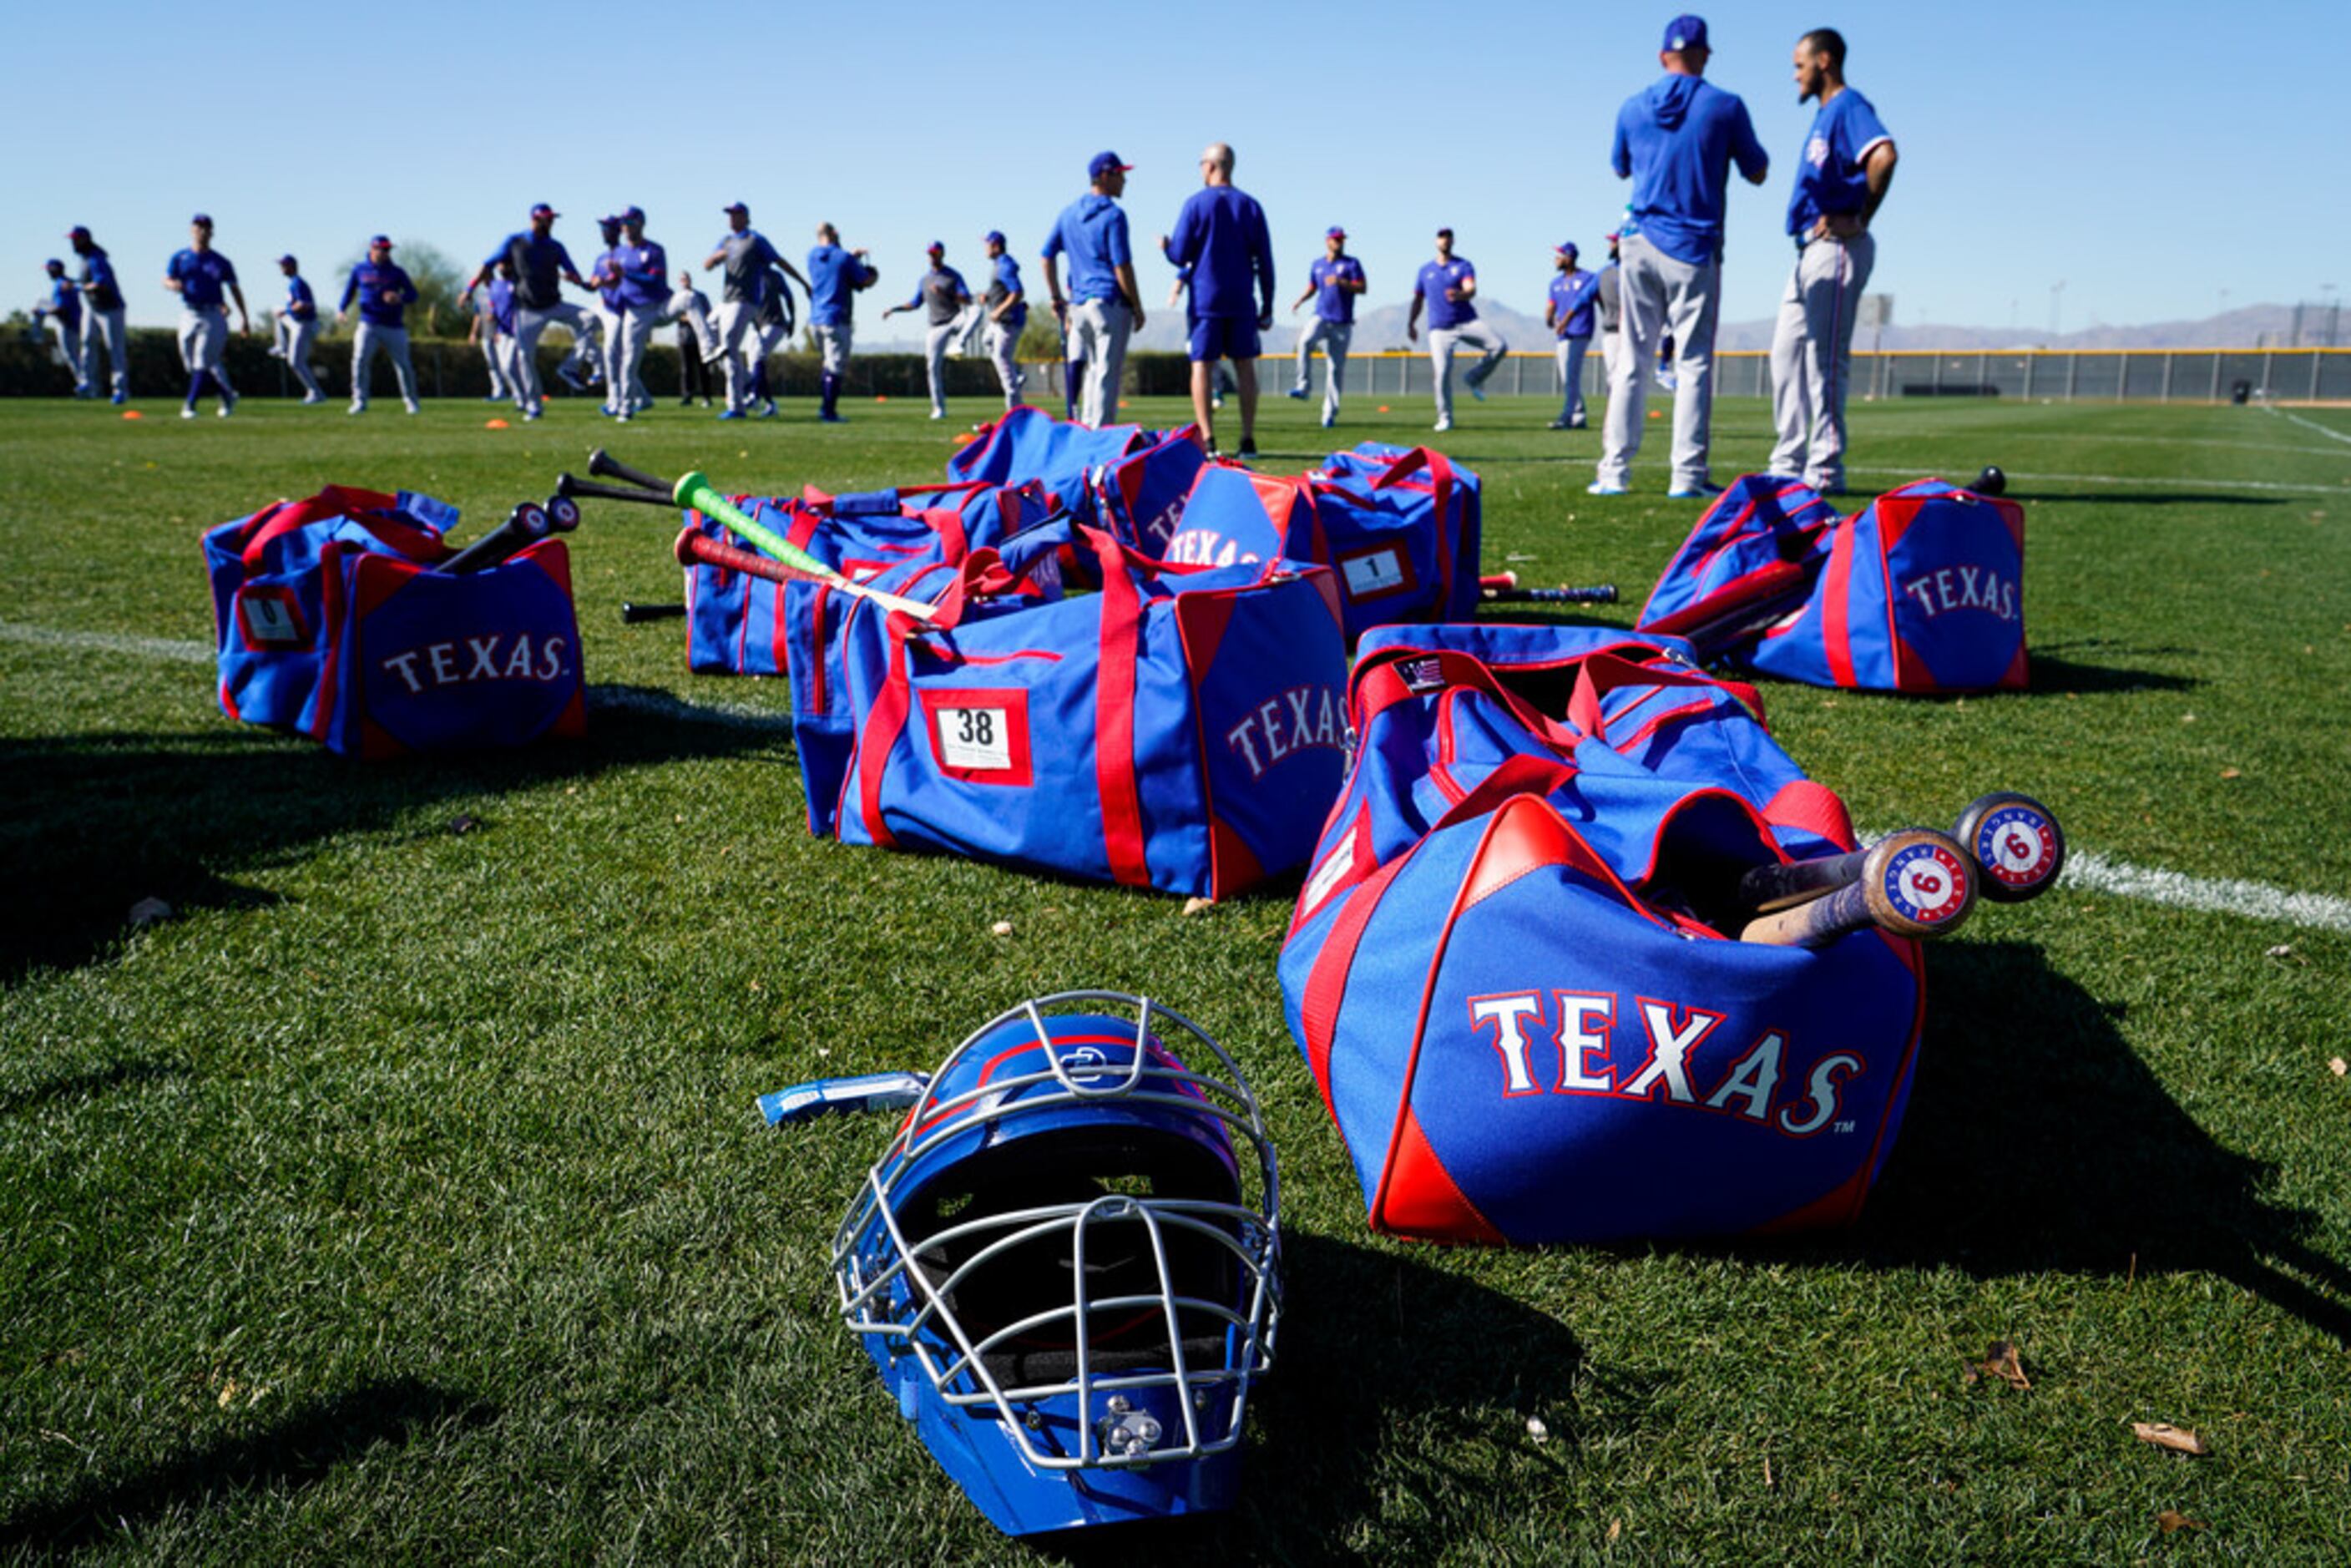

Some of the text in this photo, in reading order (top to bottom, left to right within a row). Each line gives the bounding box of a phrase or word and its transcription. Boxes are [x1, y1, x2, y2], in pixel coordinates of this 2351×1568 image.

[1364, 557, 1380, 577] 1
[1906, 566, 2014, 620] TEXAS
[384, 634, 565, 692] TEXAS
[957, 709, 993, 746] 38
[1468, 989, 1866, 1137] TEXAS
